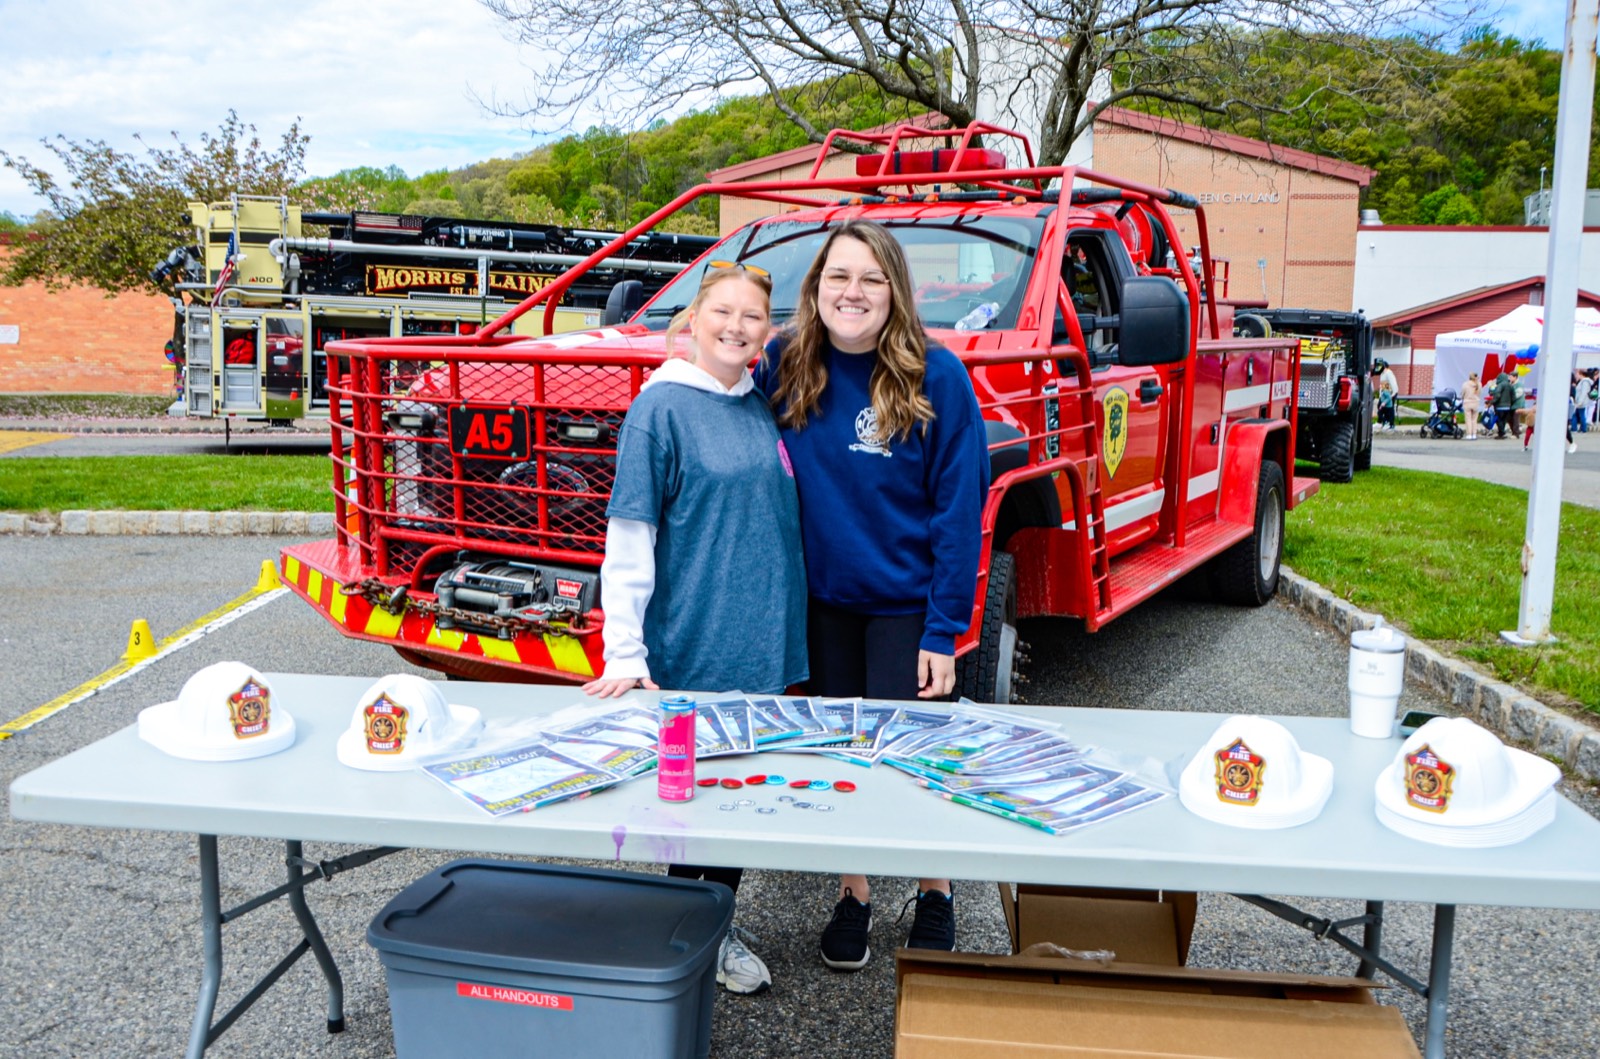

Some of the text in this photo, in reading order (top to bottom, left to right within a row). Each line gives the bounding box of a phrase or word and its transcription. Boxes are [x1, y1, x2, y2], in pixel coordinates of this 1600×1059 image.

[1234, 192, 1281, 204] HYLAND
[468, 227, 506, 238] BREATHING
[482, 235, 493, 243] AIR
[374, 267, 467, 291] MORRIS
[464, 413, 514, 452] A5
[134, 631, 141, 646] 3
[241, 688, 260, 699] FIRE
[373, 705, 393, 714] FIRE
[241, 723, 264, 733] CHIEF
[372, 741, 395, 749] CHIEF
[1228, 751, 1250, 761] FIRE
[1416, 756, 1438, 768] FIRE
[1225, 789, 1251, 799] CHIEF
[1412, 793, 1440, 806] CHIEF
[470, 985, 560, 1007] ALL HANDOUTS
